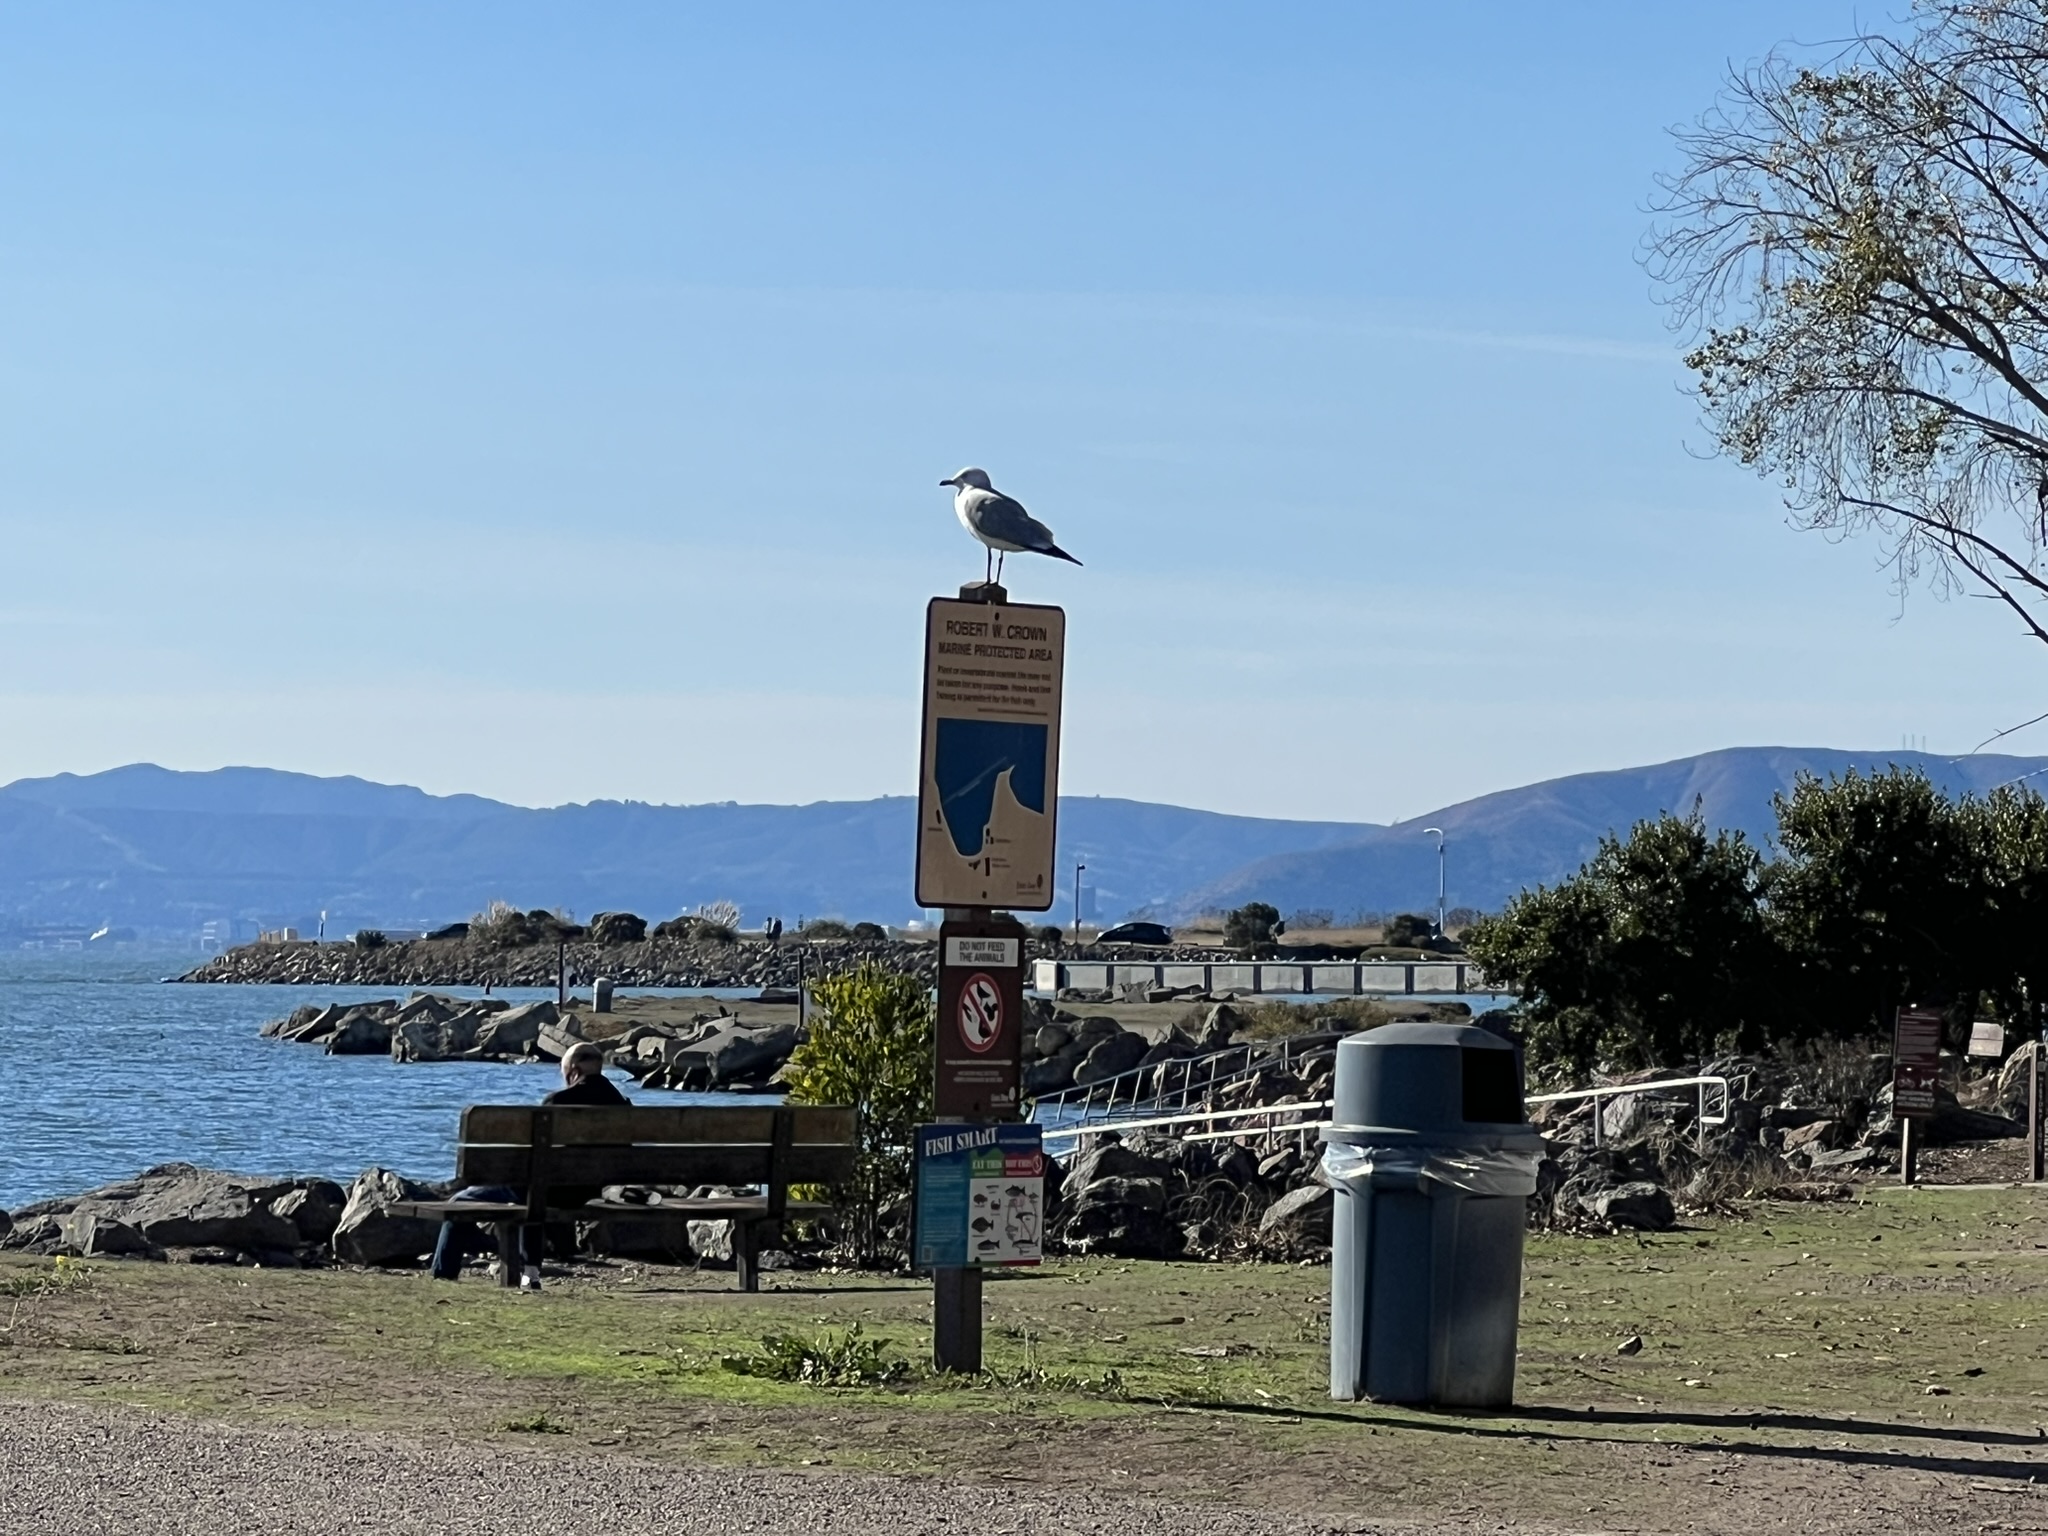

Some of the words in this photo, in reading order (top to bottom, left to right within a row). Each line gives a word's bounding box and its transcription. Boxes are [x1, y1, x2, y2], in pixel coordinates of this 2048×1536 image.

[946, 620, 988, 637] ROBERT
[992, 624, 1005, 639] W.
[1007, 625, 1047, 641] CROWN
[938, 642, 971, 656] MARINE
[974, 644, 1026, 660] PROTECTED
[1028, 649, 1053, 661] AREA
[959, 941, 970, 951] DO
[972, 942, 985, 951] NOT
[988, 942, 1005, 952] FEED
[960, 952, 972, 962] THE
[974, 952, 1005, 963] ANIMALS
[925, 1136, 953, 1157] FISH
[956, 1126, 998, 1151] SMART
